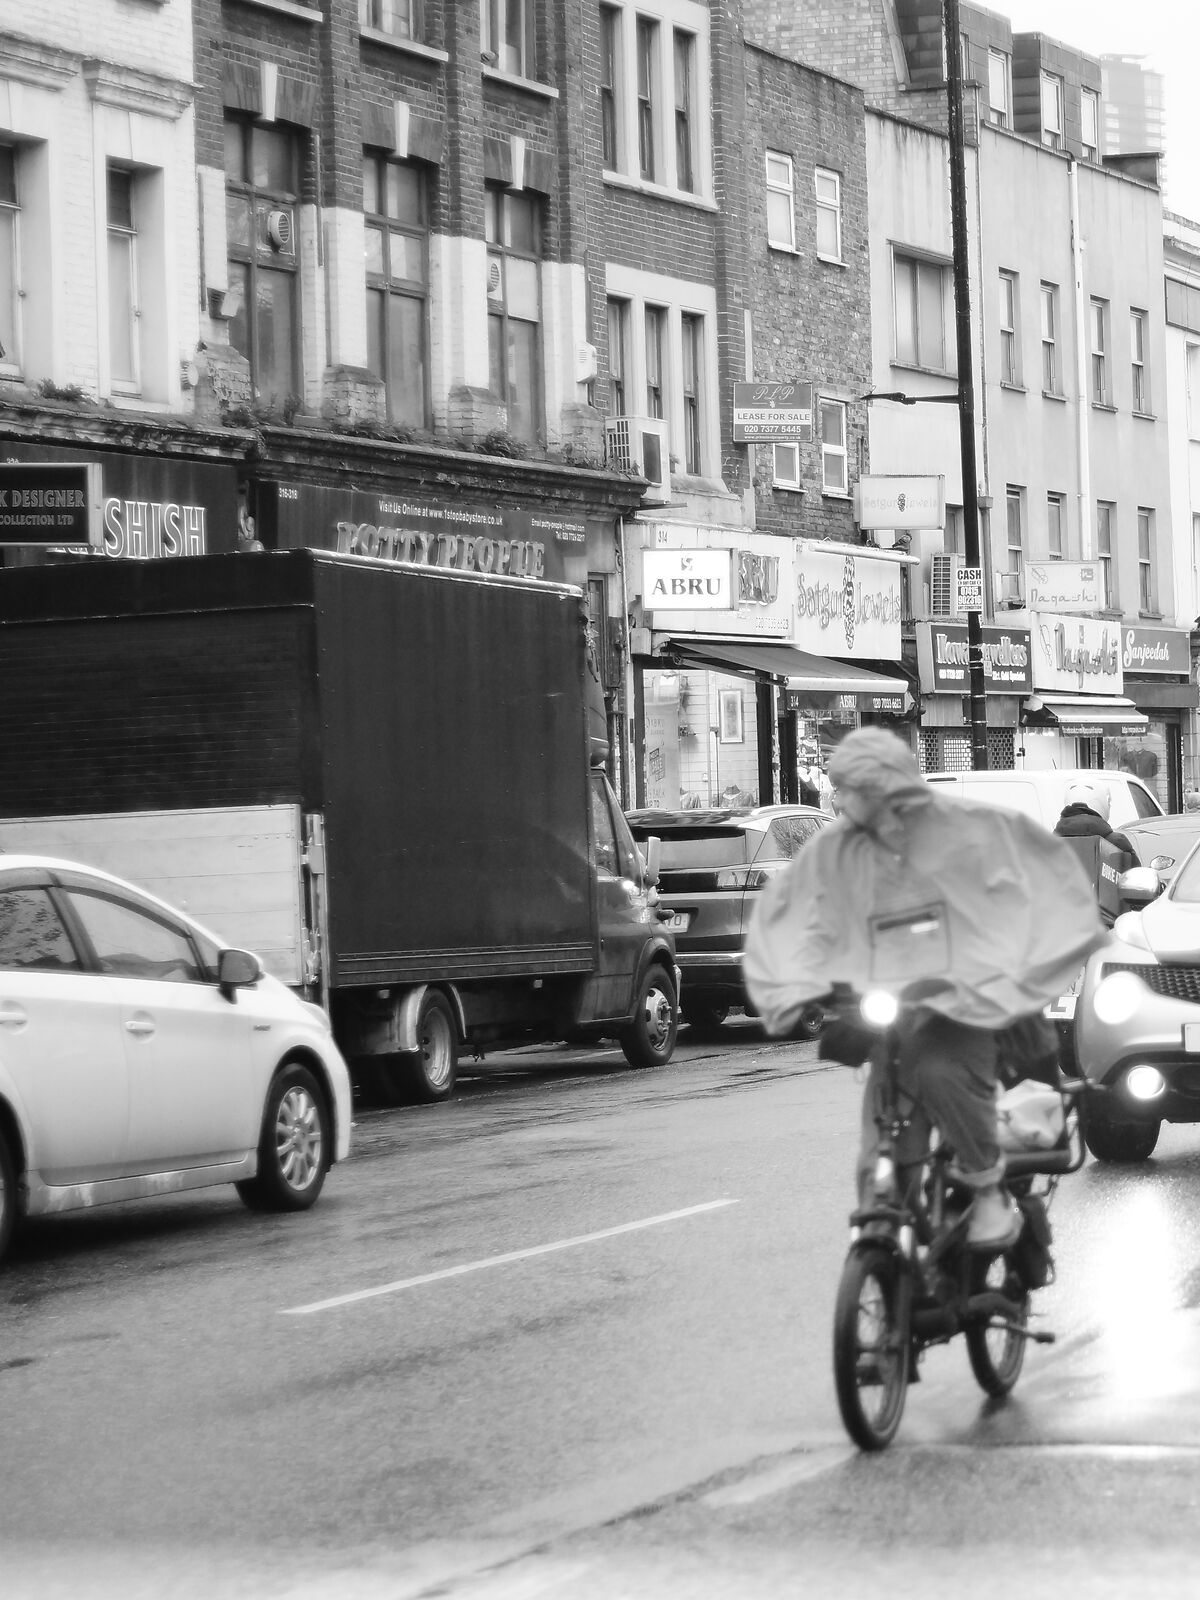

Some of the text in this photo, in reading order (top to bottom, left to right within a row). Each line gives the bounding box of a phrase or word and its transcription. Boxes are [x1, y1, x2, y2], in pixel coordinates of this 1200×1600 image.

[788, 413, 810, 421] SALE
[744, 425, 801, 433] 020 7377 5445
[12, 489, 85, 508] DESIGNER
[379, 500, 393, 513] Visit
[393, 502, 401, 514] Us
[402, 504, 421, 516] Online
[421, 507, 428, 517] at
[57, 515, 74, 526] LTD
[337, 521, 545, 578] POTTY PEOPLE
[957, 569, 982, 580] CASH
[652, 578, 721, 595] ABRU
[1124, 630, 1170, 667] Sanjeedah
[840, 695, 857, 708] ABRU
